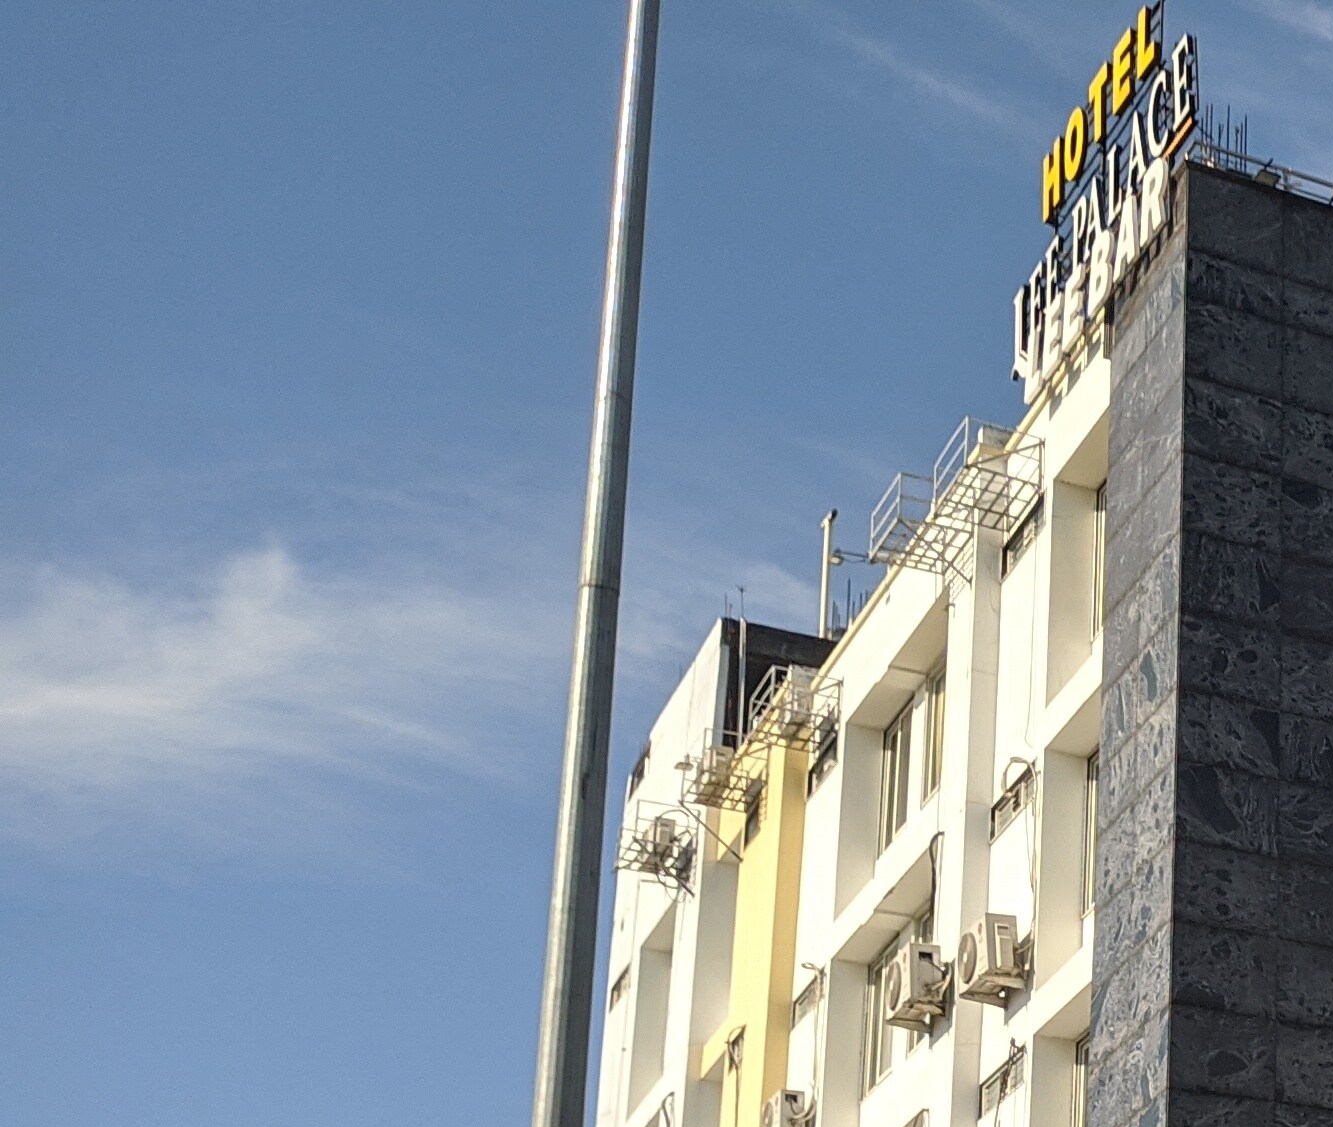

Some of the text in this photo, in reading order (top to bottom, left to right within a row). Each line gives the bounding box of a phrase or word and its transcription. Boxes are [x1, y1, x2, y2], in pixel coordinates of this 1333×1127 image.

[1042, 4, 1161, 224] HOTEL
[1024, 157, 1169, 405] LEE BAR
